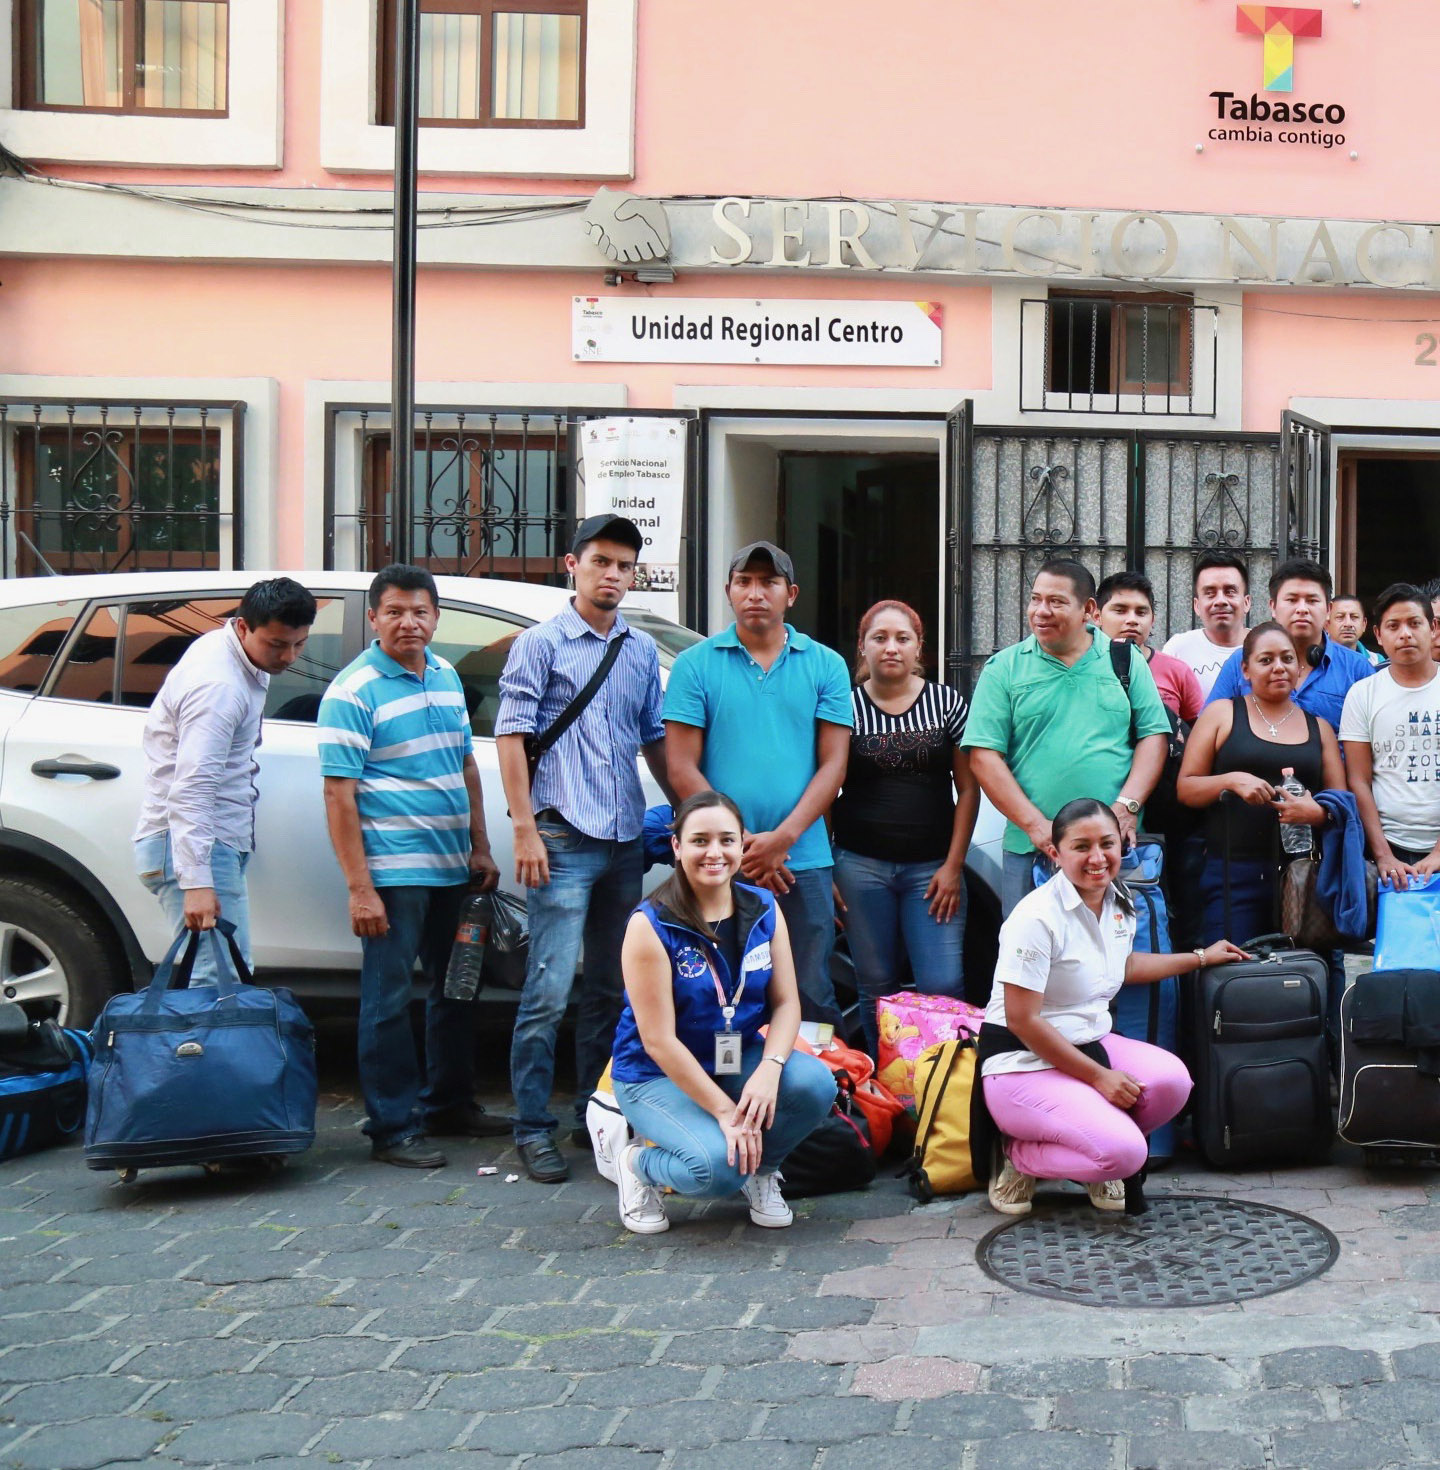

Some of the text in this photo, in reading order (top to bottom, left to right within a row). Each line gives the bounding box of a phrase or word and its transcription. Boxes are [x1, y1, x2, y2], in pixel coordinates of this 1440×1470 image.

[1209, 91, 1346, 124] Tabasco
[1208, 126, 1346, 148] cambia contigo
[710, 196, 1178, 278] SERVICIO
[631, 315, 904, 347] Unidad Regional Centro
[600, 459, 667, 468] Servicio Nacional
[597, 470, 670, 479] de Empleo Tabasco
[611, 496, 656, 509] Unidad
[1379, 755, 1398, 768] IN
[745, 951, 769, 964] SAMSU
